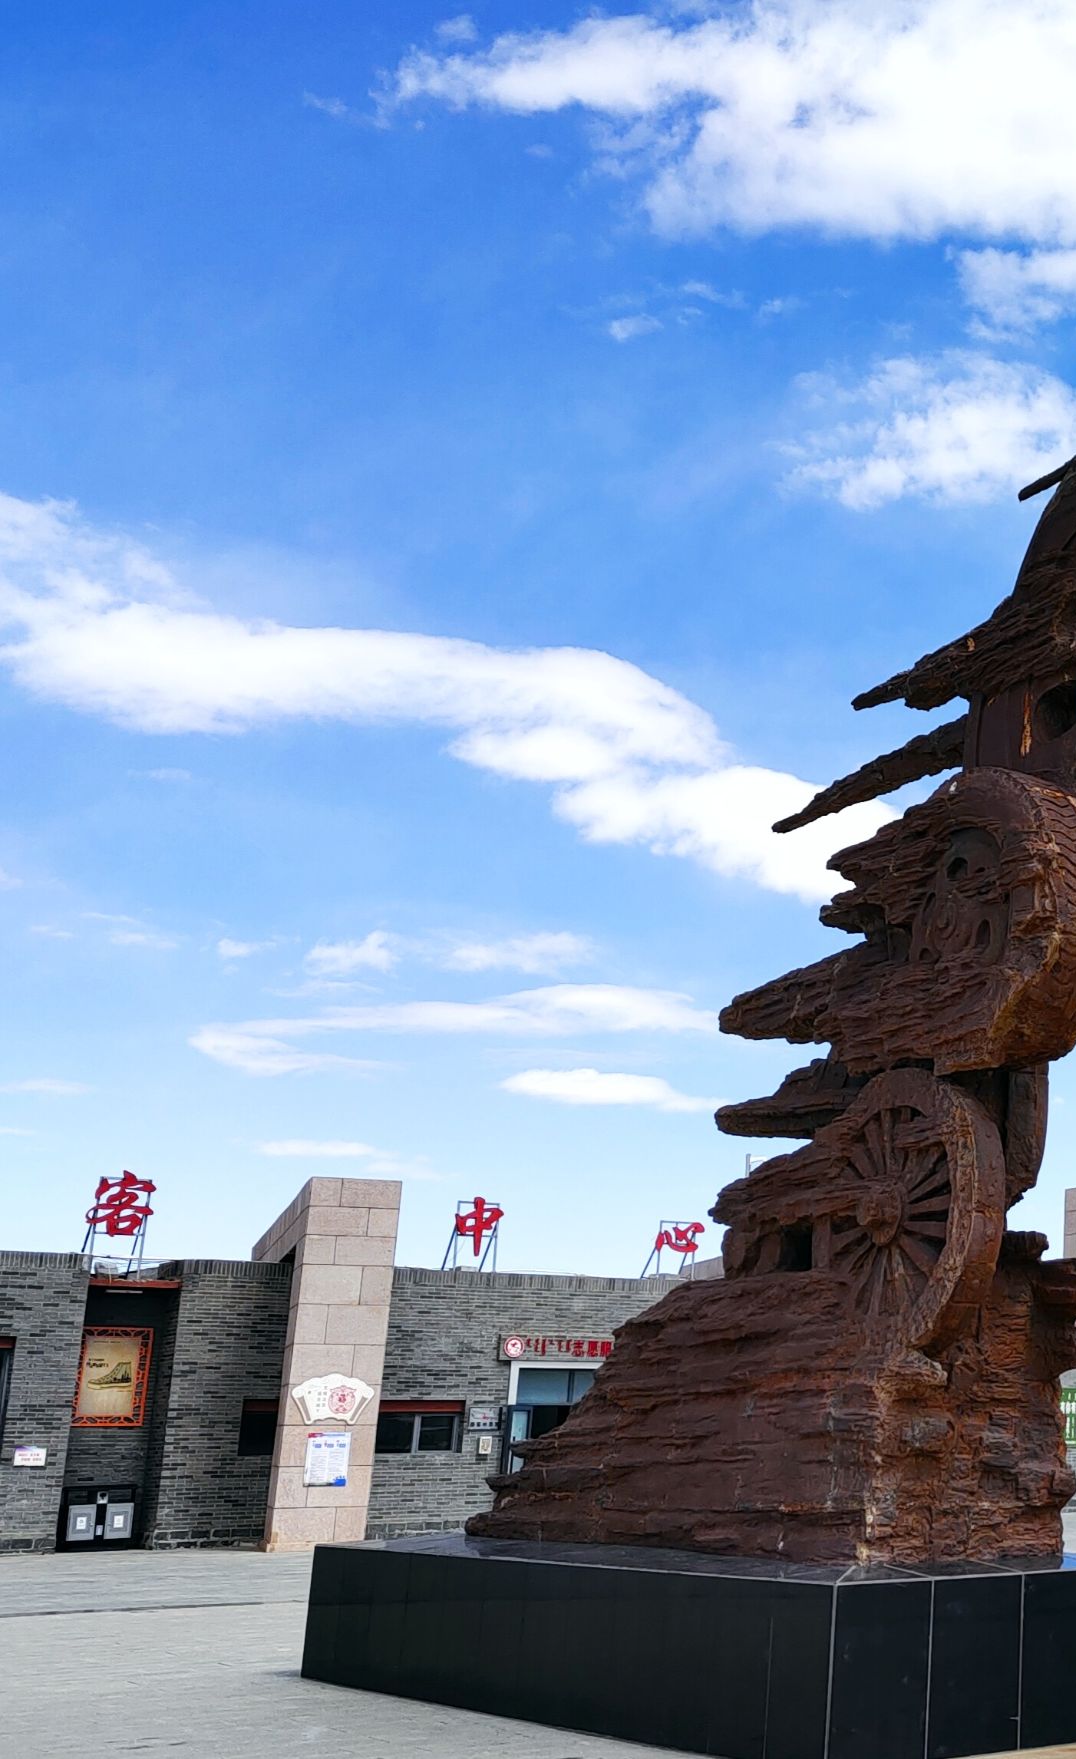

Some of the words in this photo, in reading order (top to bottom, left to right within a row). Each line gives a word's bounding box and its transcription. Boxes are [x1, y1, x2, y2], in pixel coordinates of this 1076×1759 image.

[85, 1170, 157, 1237] 客
[455, 1197, 504, 1256] 中
[655, 1222, 705, 1253] 心
